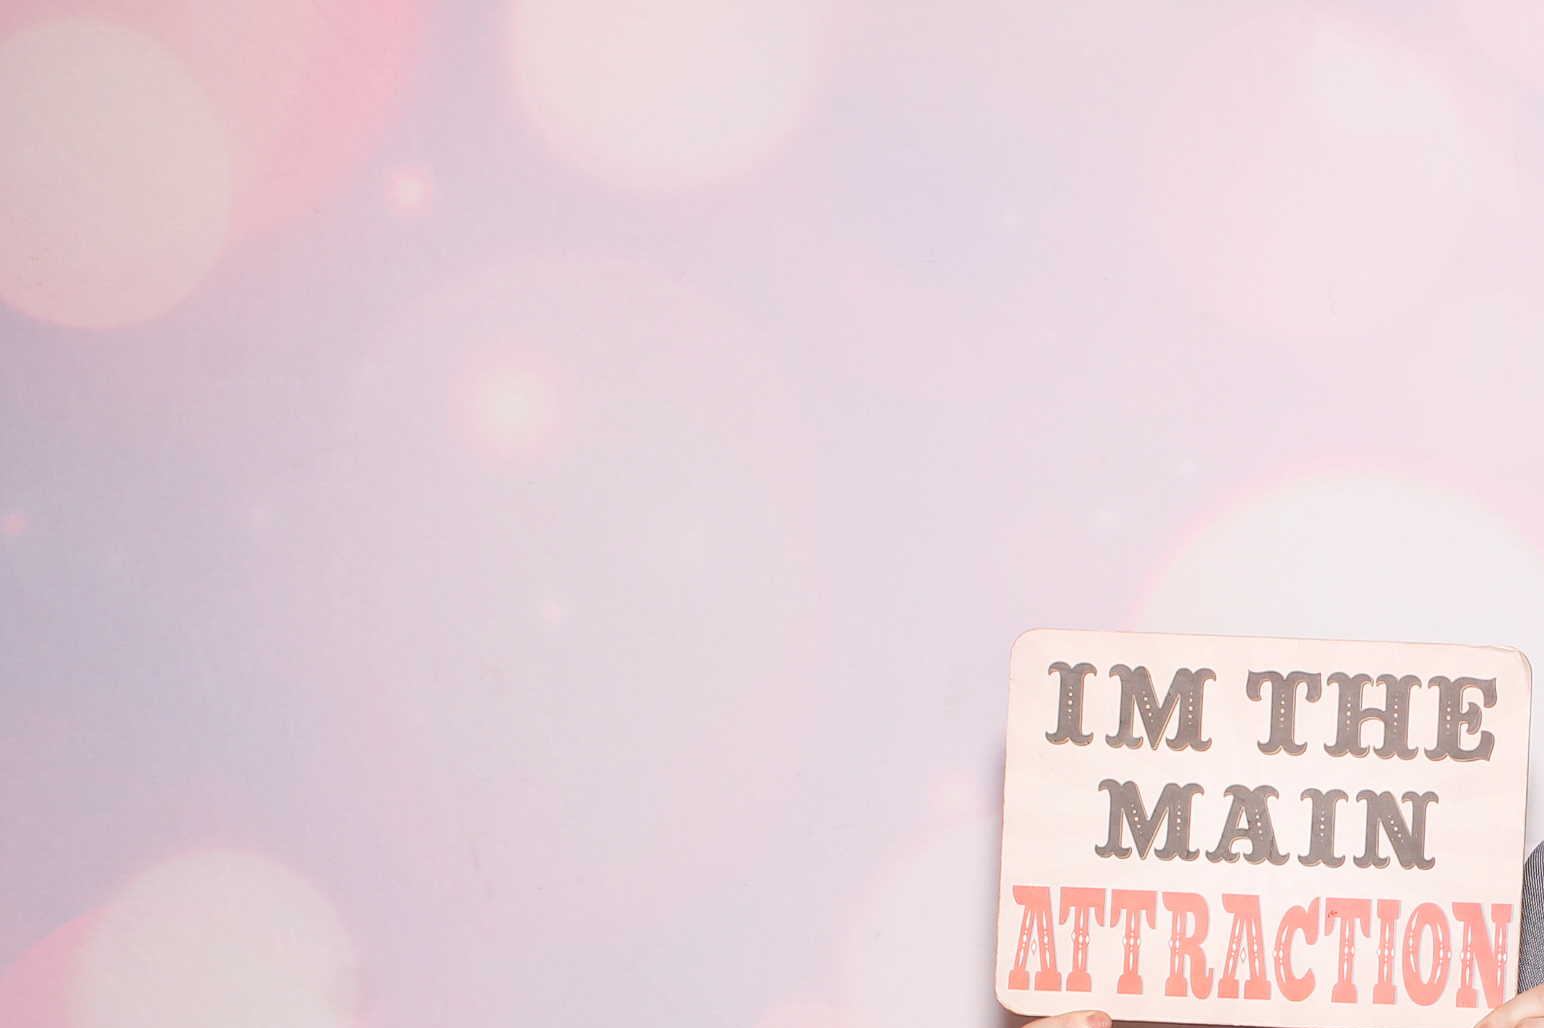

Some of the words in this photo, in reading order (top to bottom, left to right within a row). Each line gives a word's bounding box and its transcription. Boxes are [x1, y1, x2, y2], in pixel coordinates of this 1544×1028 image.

[1045, 661, 1217, 751] IM
[1245, 668, 1498, 762] THE
[1094, 778, 1440, 871] MAIN
[1007, 884, 1514, 1009] ATTRACTION
